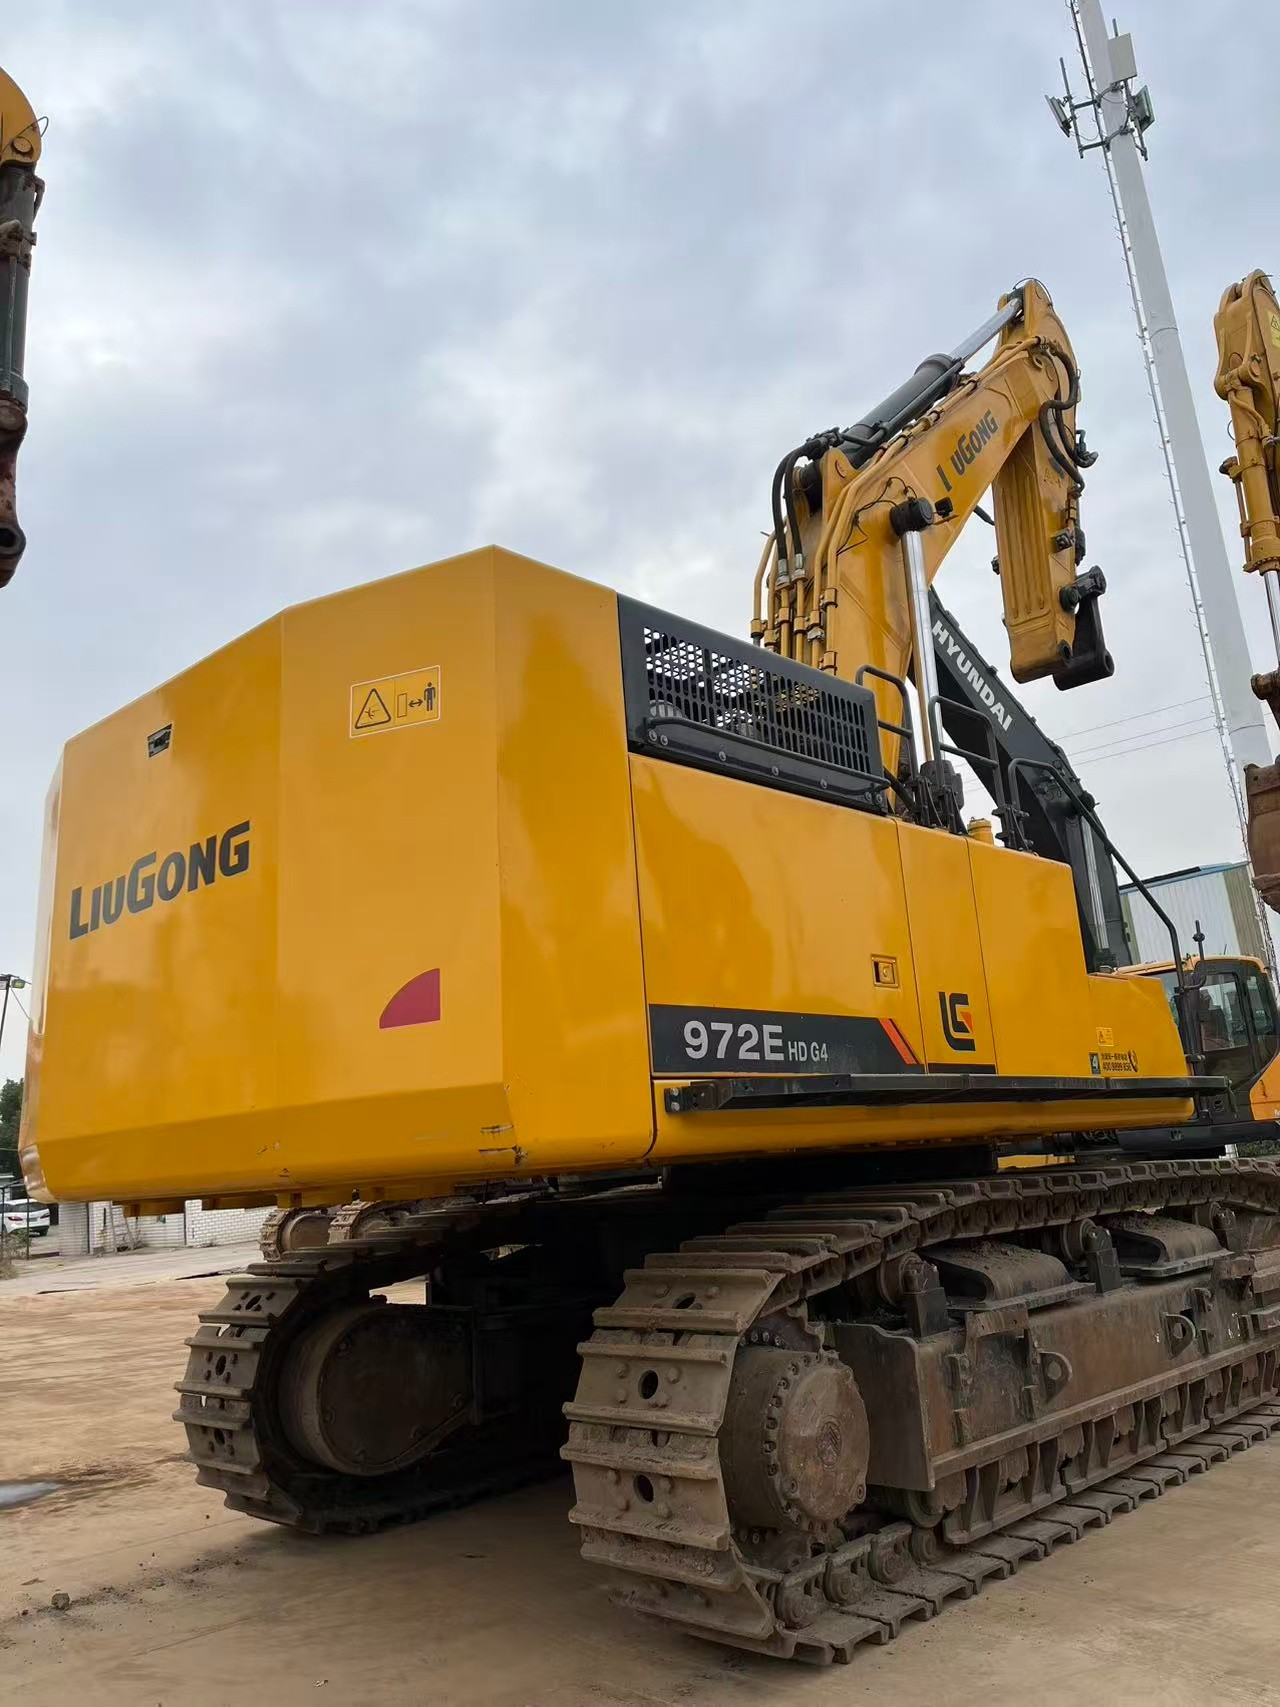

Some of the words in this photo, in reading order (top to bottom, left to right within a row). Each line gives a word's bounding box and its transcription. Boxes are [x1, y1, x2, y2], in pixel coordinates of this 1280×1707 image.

[931, 620, 1013, 732] HYUNDAI
[683, 1020, 784, 1061] 972E
[788, 1041, 808, 1062] HD
[810, 1042, 828, 1062] G4
